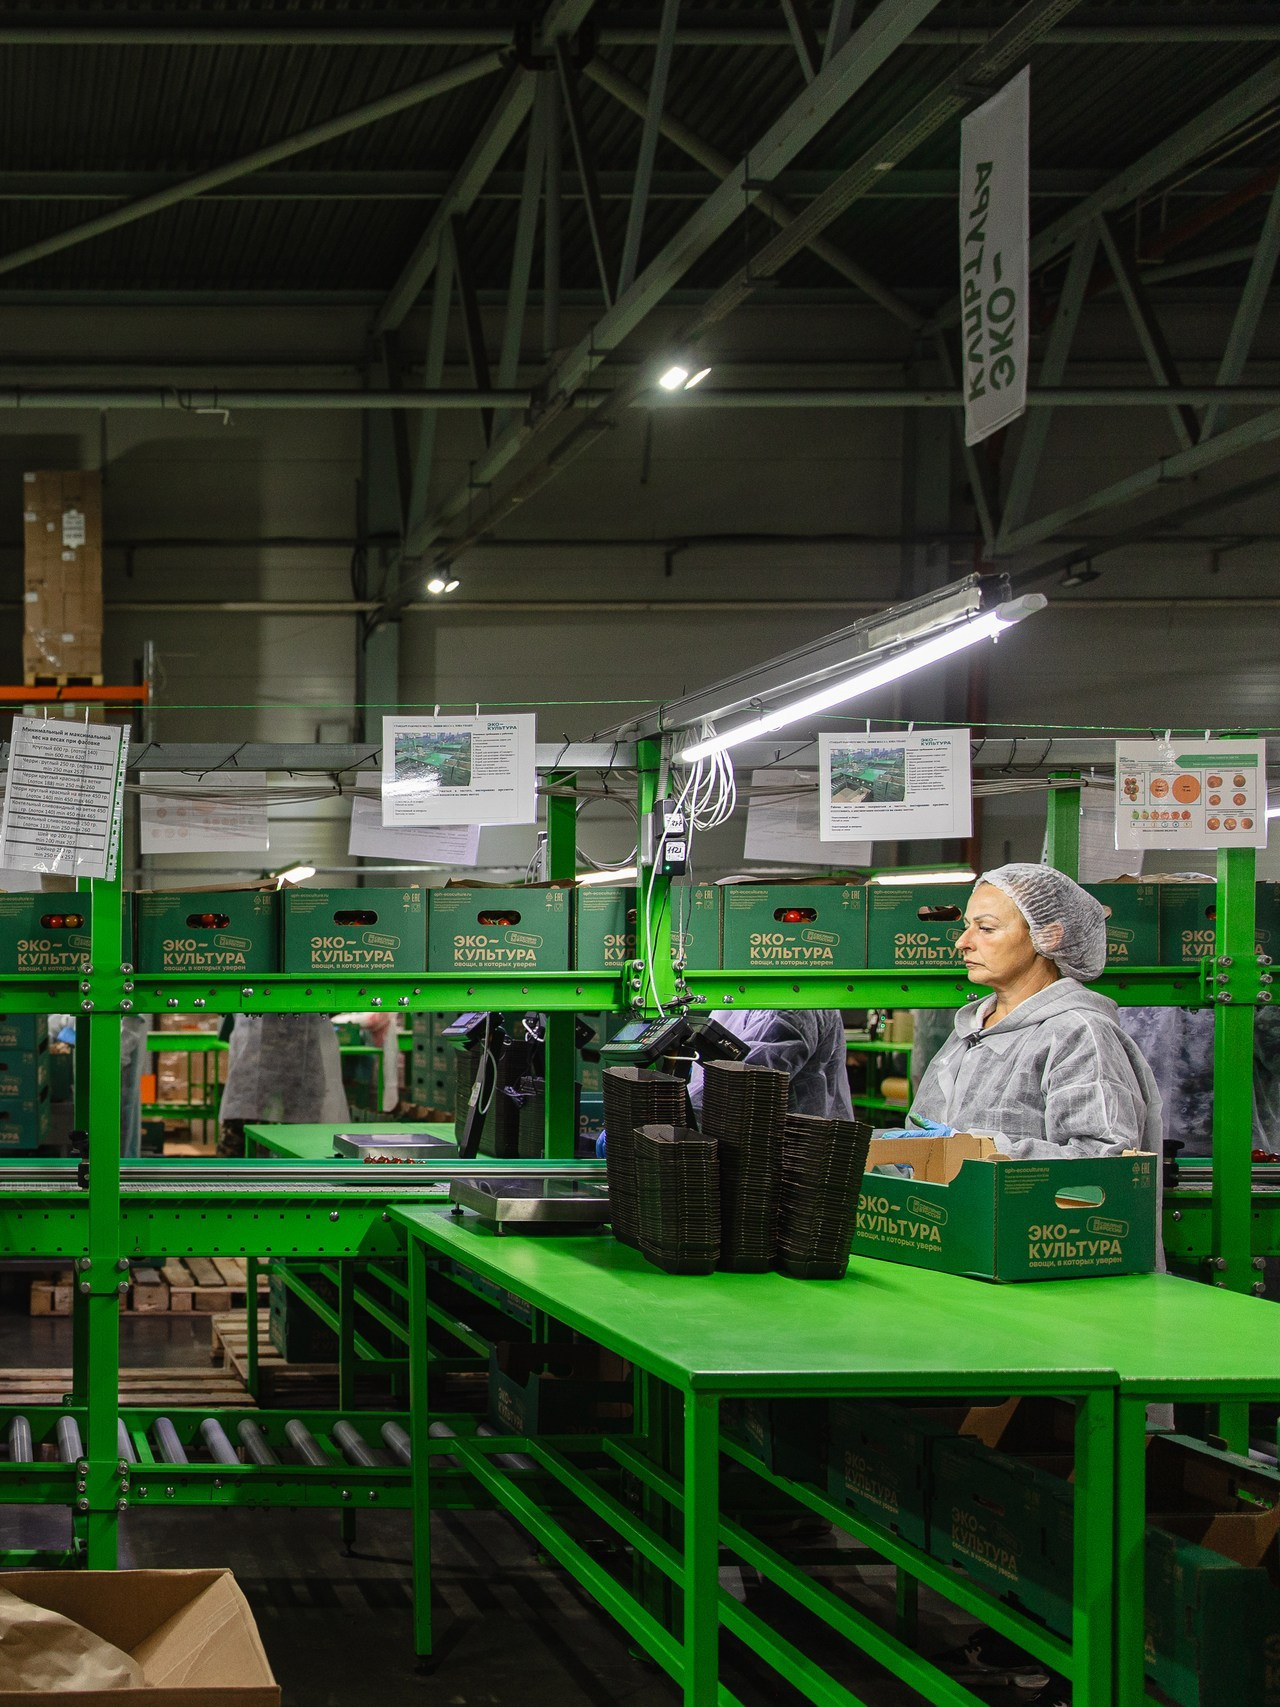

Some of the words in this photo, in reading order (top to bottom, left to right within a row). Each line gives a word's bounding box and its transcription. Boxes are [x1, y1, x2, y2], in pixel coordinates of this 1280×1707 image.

[22, 727, 63, 735] Минимальный
[69, 732, 111, 740] максимальный
[604, 934, 636, 946] ЭКО
[1182, 930, 1215, 942] ЭКО
[312, 950, 394, 962] КУЛЬТУРА
[454, 949, 537, 961] КУЛЬТУРА
[750, 947, 833, 959] КУЛЬТУРА
[896, 947, 964, 958] КУЛЬТУ
[18, 953, 90, 965] КУЛЬТУР
[163, 953, 246, 965] КУЛЬТУРА
[856, 1212, 941, 1243] КУЛЬТУРА
[1029, 1240, 1122, 1259] КУЛЬТУРА
[1063, 1258, 1094, 1267] которых
[1096, 1257, 1122, 1266] уверен
[845, 1467, 898, 1507] КУЛЬТУРА
[952, 1523, 1017, 1572] КУЛЬТУРА
